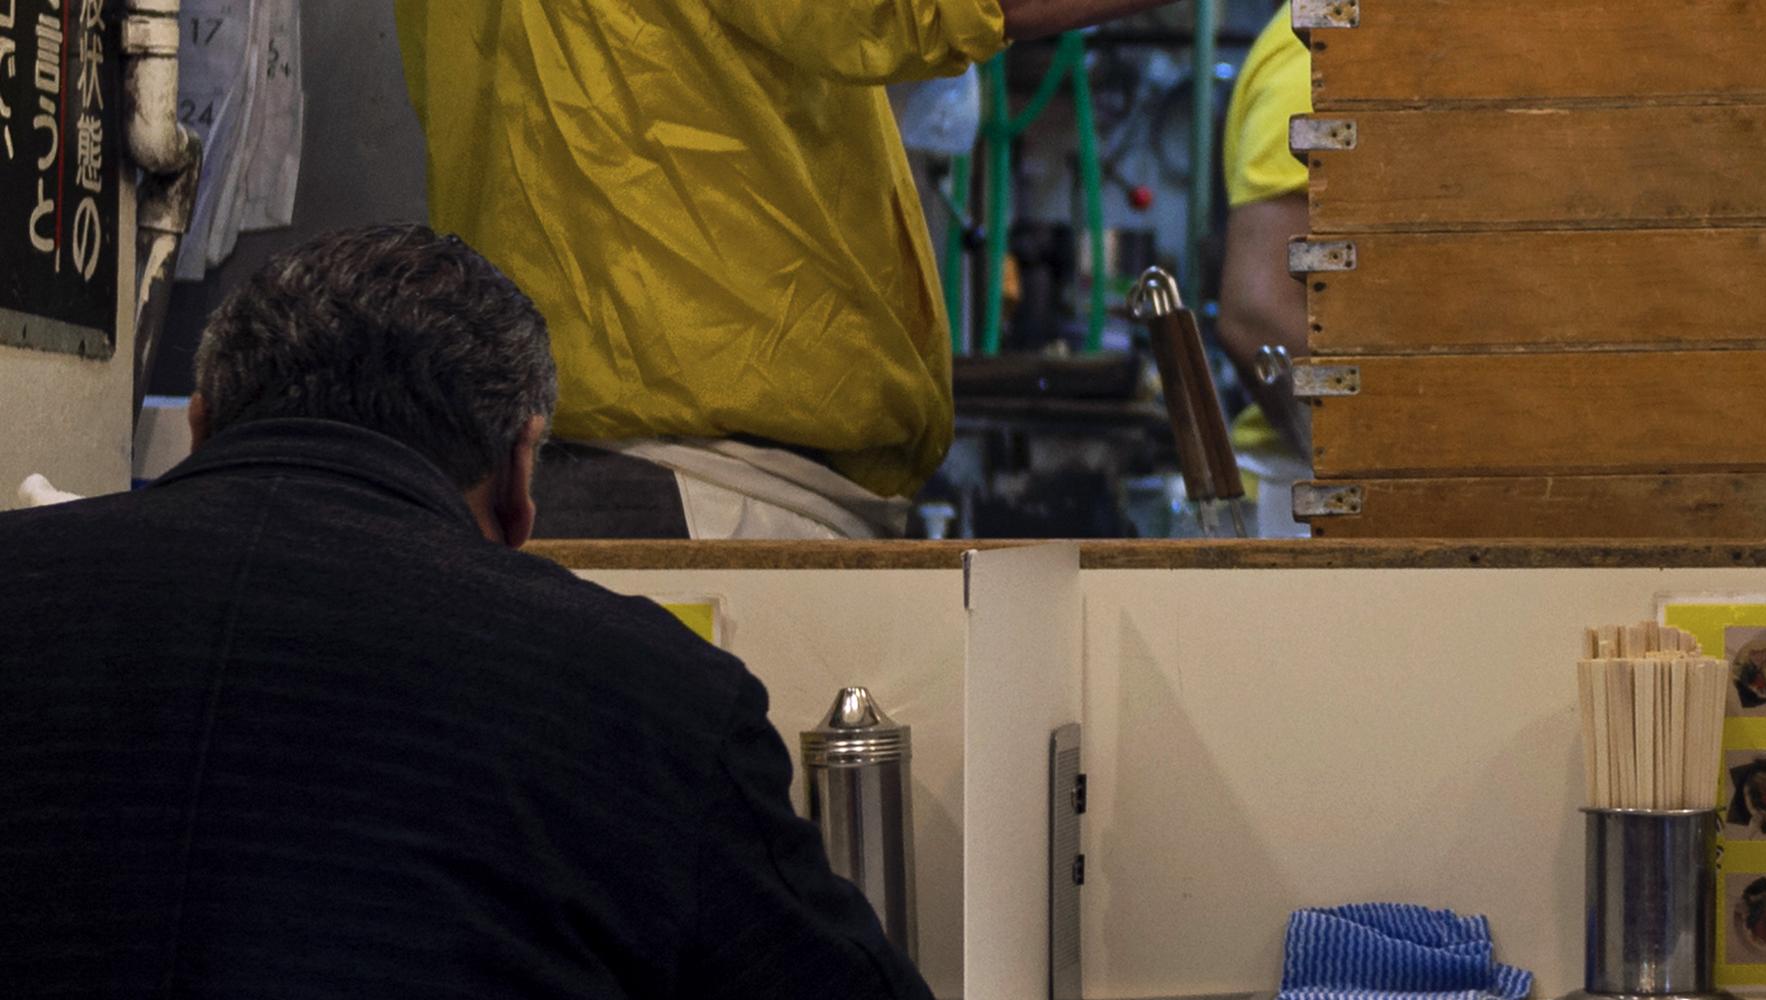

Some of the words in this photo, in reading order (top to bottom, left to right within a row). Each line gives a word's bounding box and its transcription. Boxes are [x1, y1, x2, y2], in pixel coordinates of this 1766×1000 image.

[190, 17, 224, 45] 17
[29, 0, 63, 253] 言うと
[180, 99, 214, 126] 24
